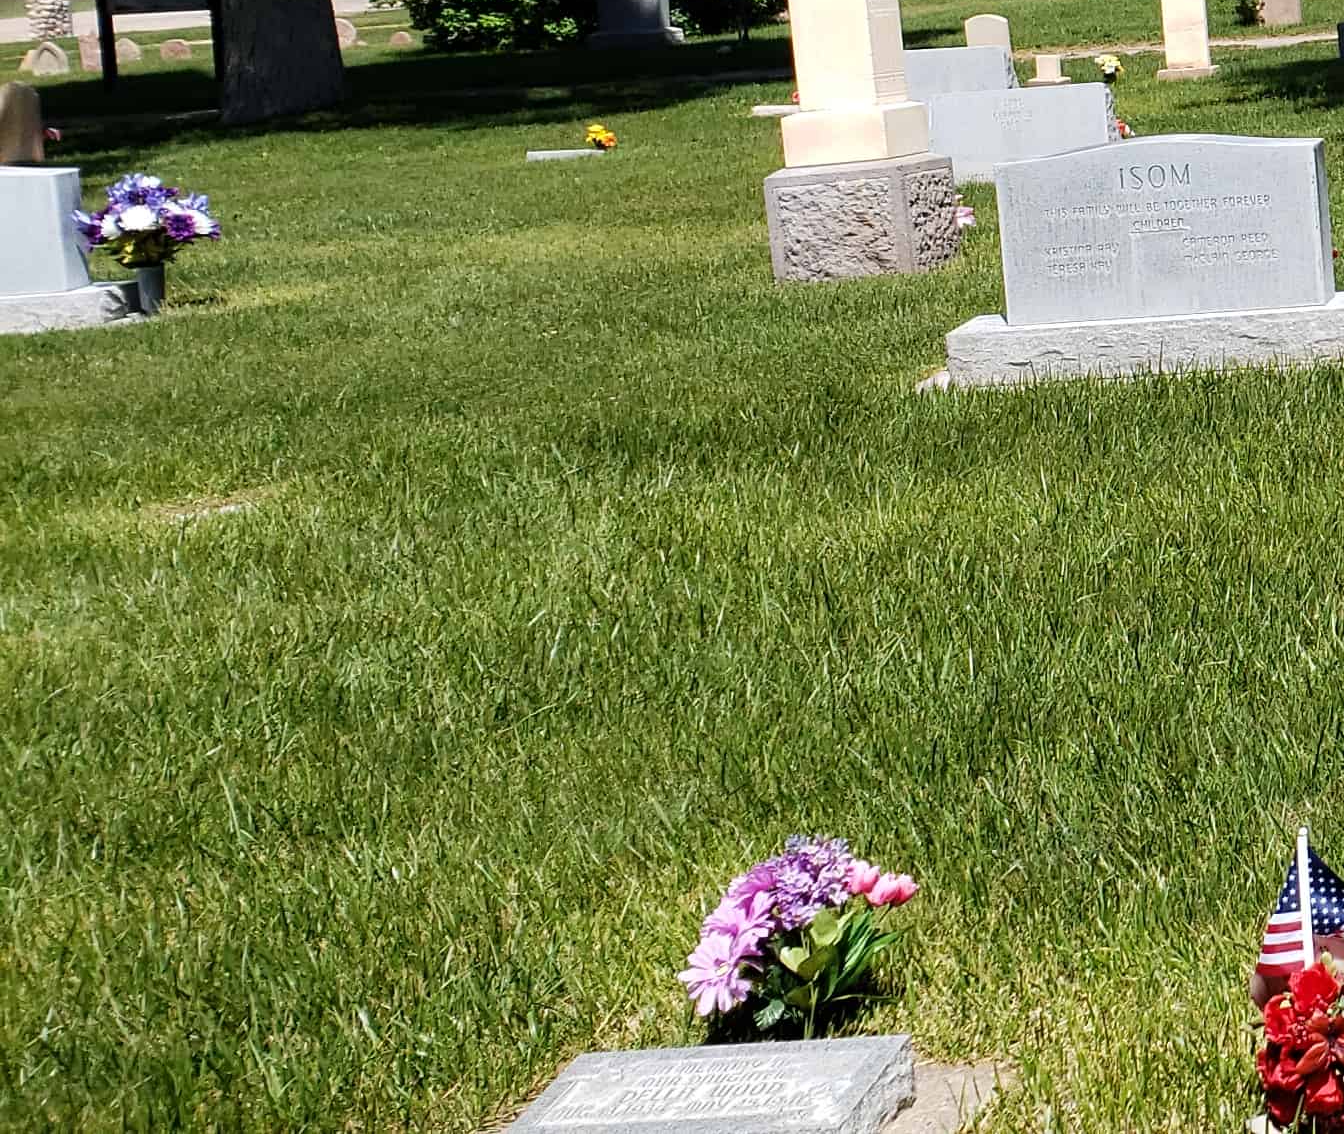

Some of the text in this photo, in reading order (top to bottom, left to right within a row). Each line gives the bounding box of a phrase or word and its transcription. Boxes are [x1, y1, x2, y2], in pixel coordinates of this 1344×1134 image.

[1118, 162, 1193, 190] ISOM
[1163, 198, 1217, 212] TOGETHER
[1221, 194, 1272, 207] FOREVER
[1132, 217, 1186, 231] CHILDREN
